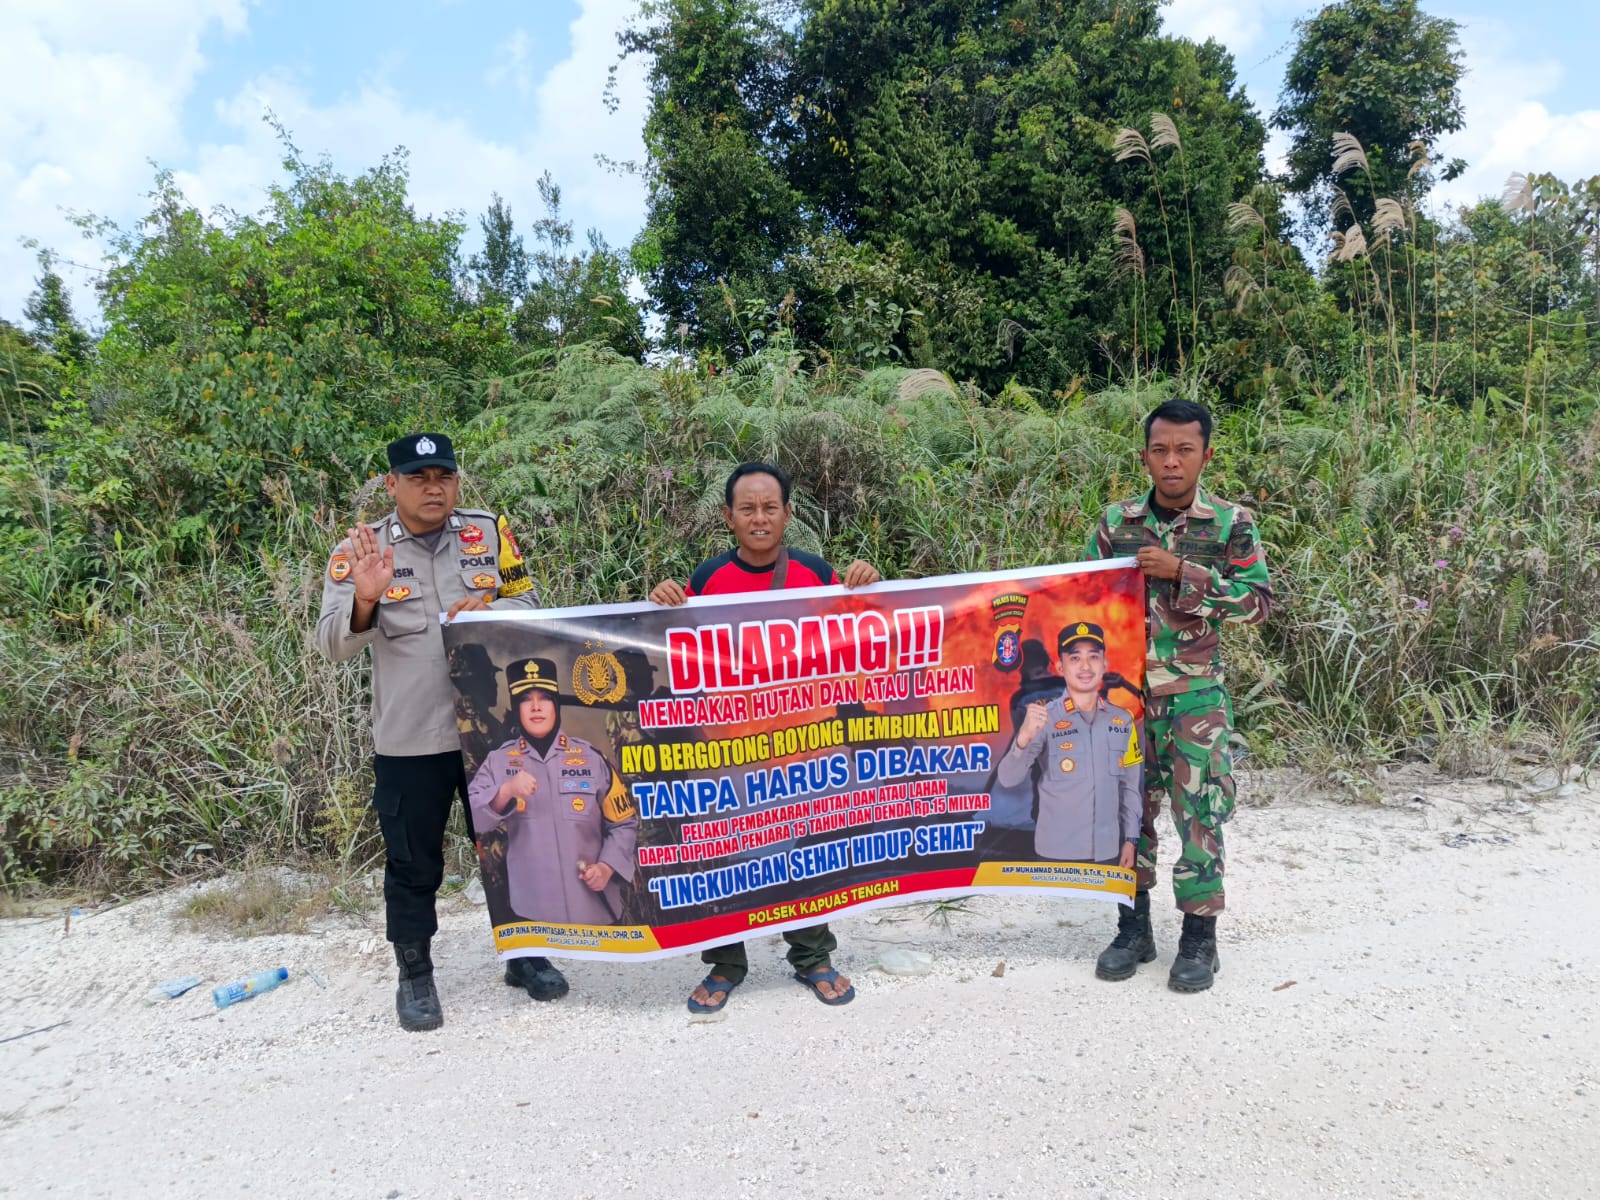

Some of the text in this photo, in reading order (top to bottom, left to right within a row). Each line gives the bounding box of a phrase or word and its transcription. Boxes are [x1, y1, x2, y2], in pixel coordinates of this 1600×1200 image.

[460, 556, 495, 568] POLRI
[667, 605, 944, 694] DILARANG !!!
[639, 665, 974, 728] MEMBAKAR HUTAN DAN ATAU LAHAN
[621, 705, 1000, 774] AYO BERGOTONG ROYONG MEMBUKA LAHAN
[561, 769, 591, 777] POLRI
[632, 743, 991, 819] TANPA HARUS DIBAKAR
[639, 793, 991, 866] DAPAT DIPIDANA PENJARA 15 TAHUN DAN DENDA Rp.15 MILYAR
[681, 779, 948, 843] PELAKU PEMBAKARAN HUTAN DAN ATAU LAHAN
[648, 821, 985, 910] “LINGKUNGAN SEHAT HIDUP SEHAT”
[1016, 866, 1052, 874] MUHAMMAD
[1053, 867, 1081, 876] SALADIN,
[498, 926, 515, 938] AKBP
[515, 925, 530, 935] RINA
[748, 880, 899, 925] POLSEK KAPUAS TENGAH
